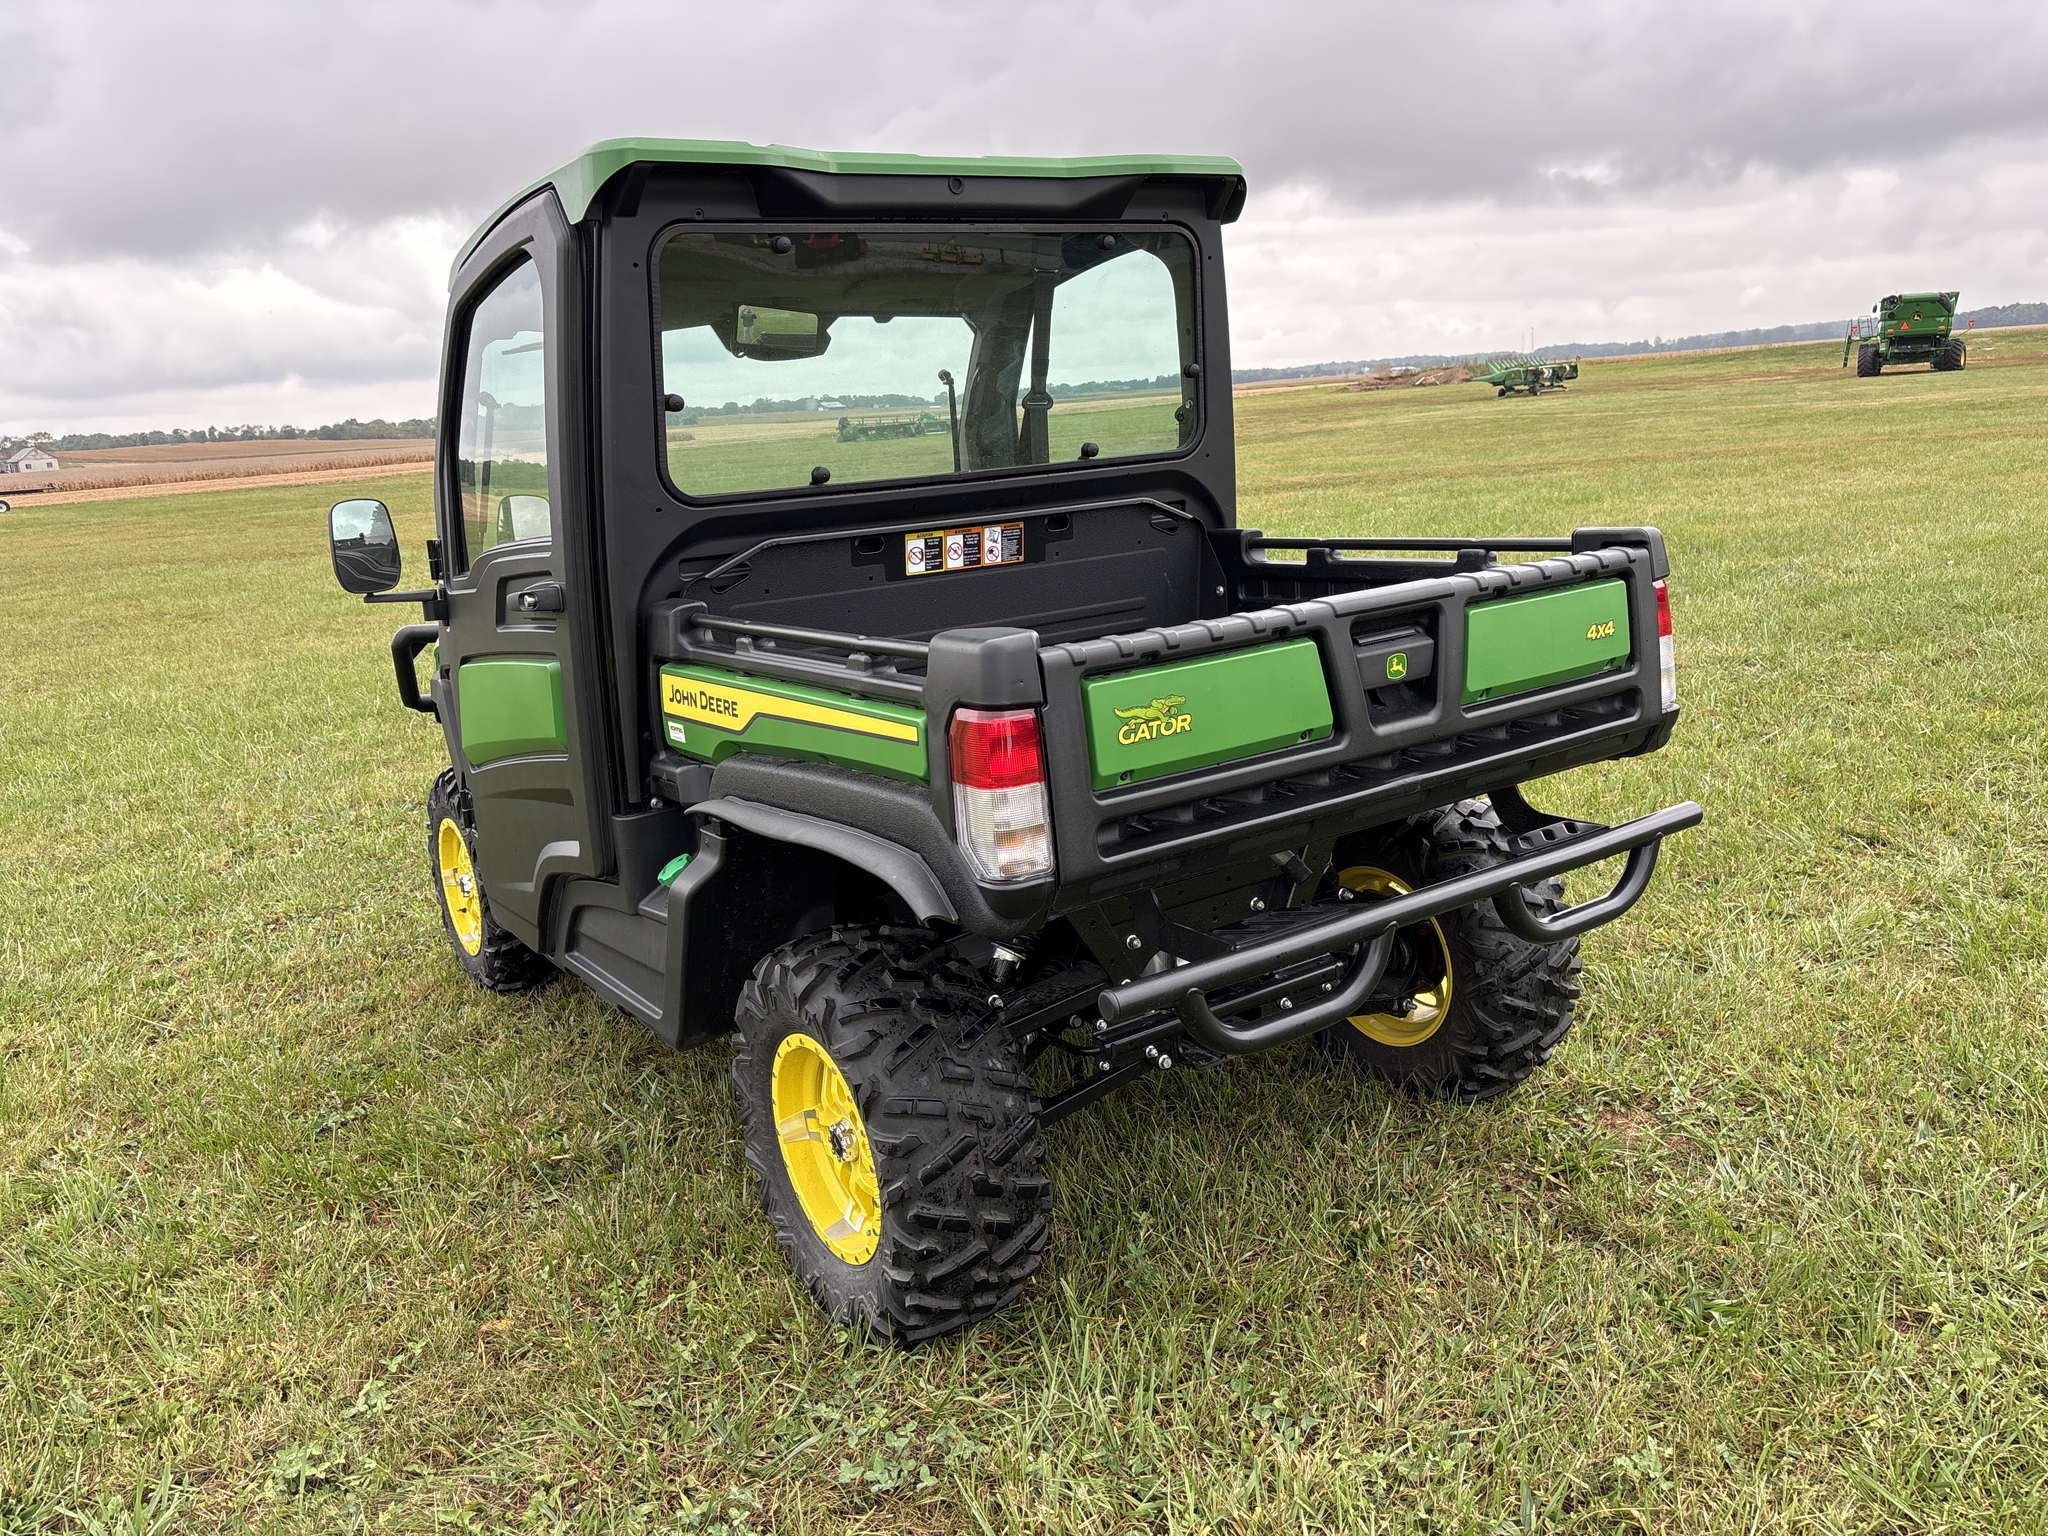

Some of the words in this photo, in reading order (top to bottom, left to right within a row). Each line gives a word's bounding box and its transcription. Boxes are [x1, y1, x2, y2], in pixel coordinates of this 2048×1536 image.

[669, 684, 698, 709] JOHN
[699, 690, 739, 718] DEERE
[1118, 713, 1192, 745] GATOR
